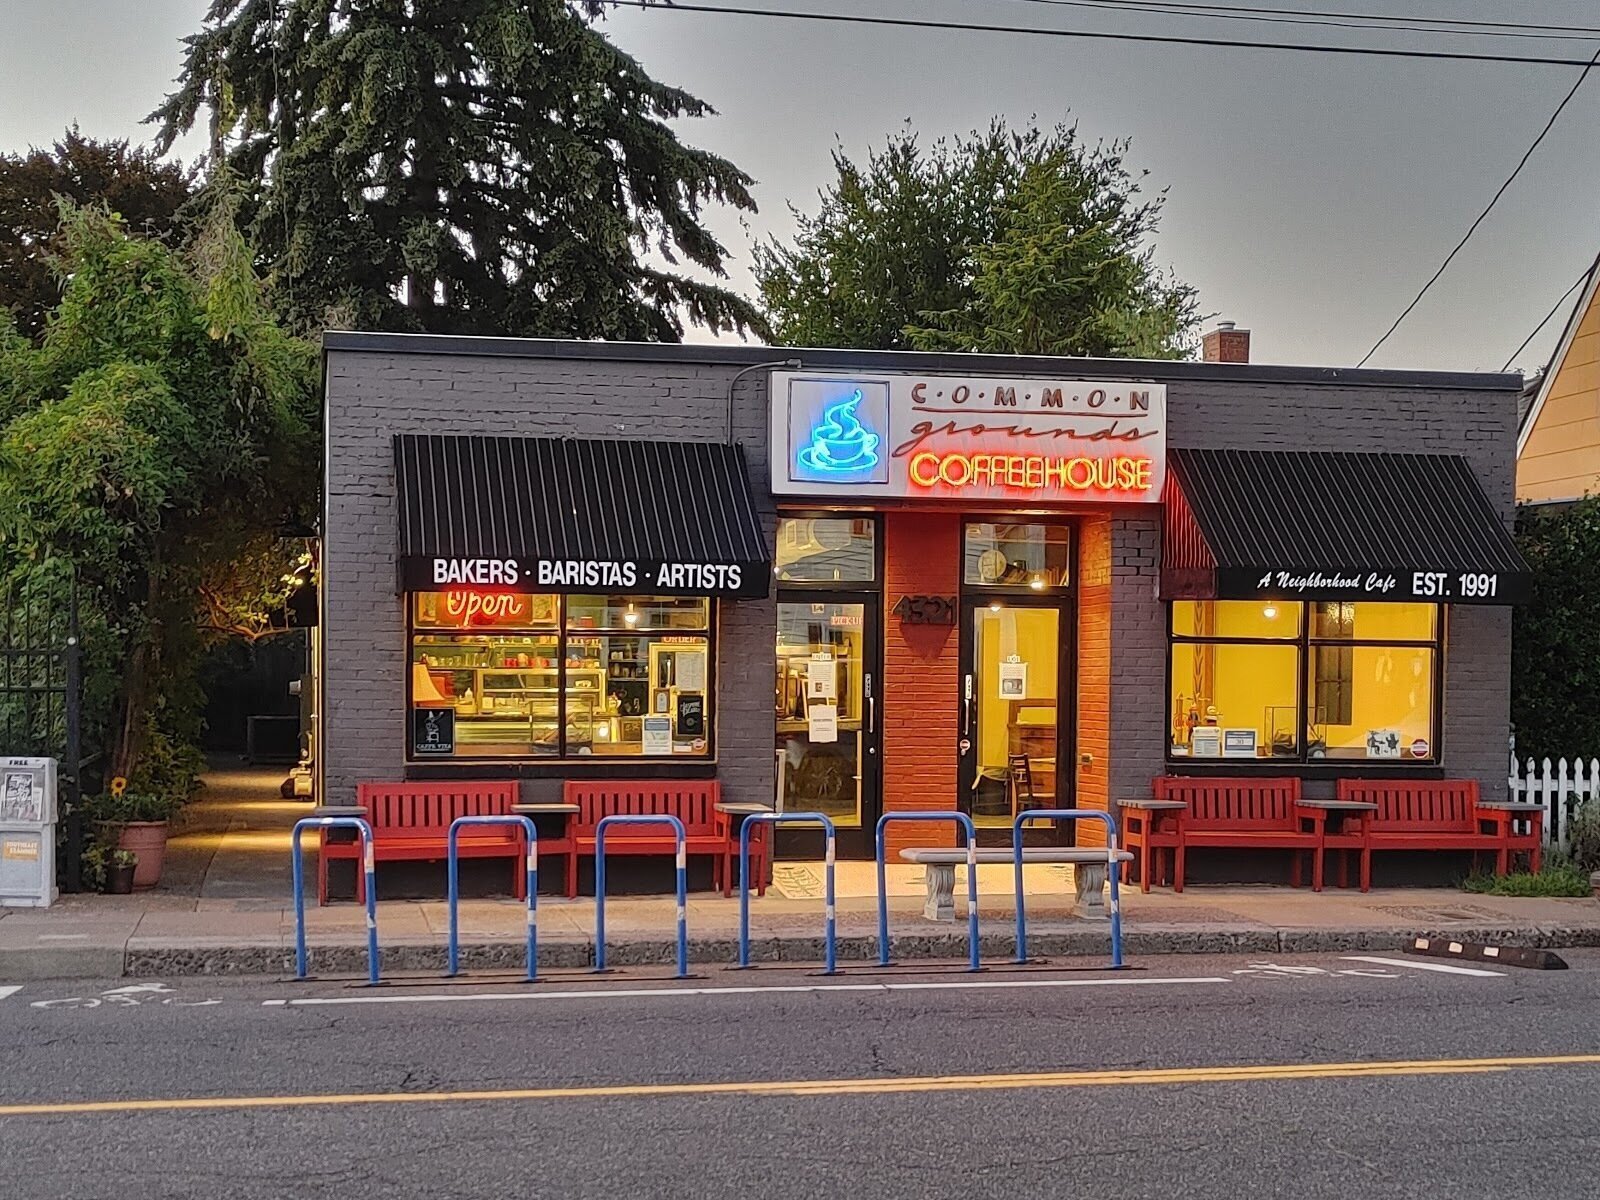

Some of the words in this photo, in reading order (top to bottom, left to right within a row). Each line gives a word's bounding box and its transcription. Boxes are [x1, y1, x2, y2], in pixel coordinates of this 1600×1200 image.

[892, 420, 1159, 458] grounds
[909, 452, 1153, 490] COFFEEHOUSE
[433, 558, 519, 585] BAKERS
[538, 560, 637, 587] BARISTAS
[656, 563, 742, 590] ARTISTS
[1257, 571, 1271, 589] A
[1276, 571, 1361, 592] Neighborhood
[1365, 572, 1397, 591] Cafe
[1412, 572, 1450, 597] EST.
[1459, 573, 1497, 597] 1991
[447, 591, 522, 627] Open
